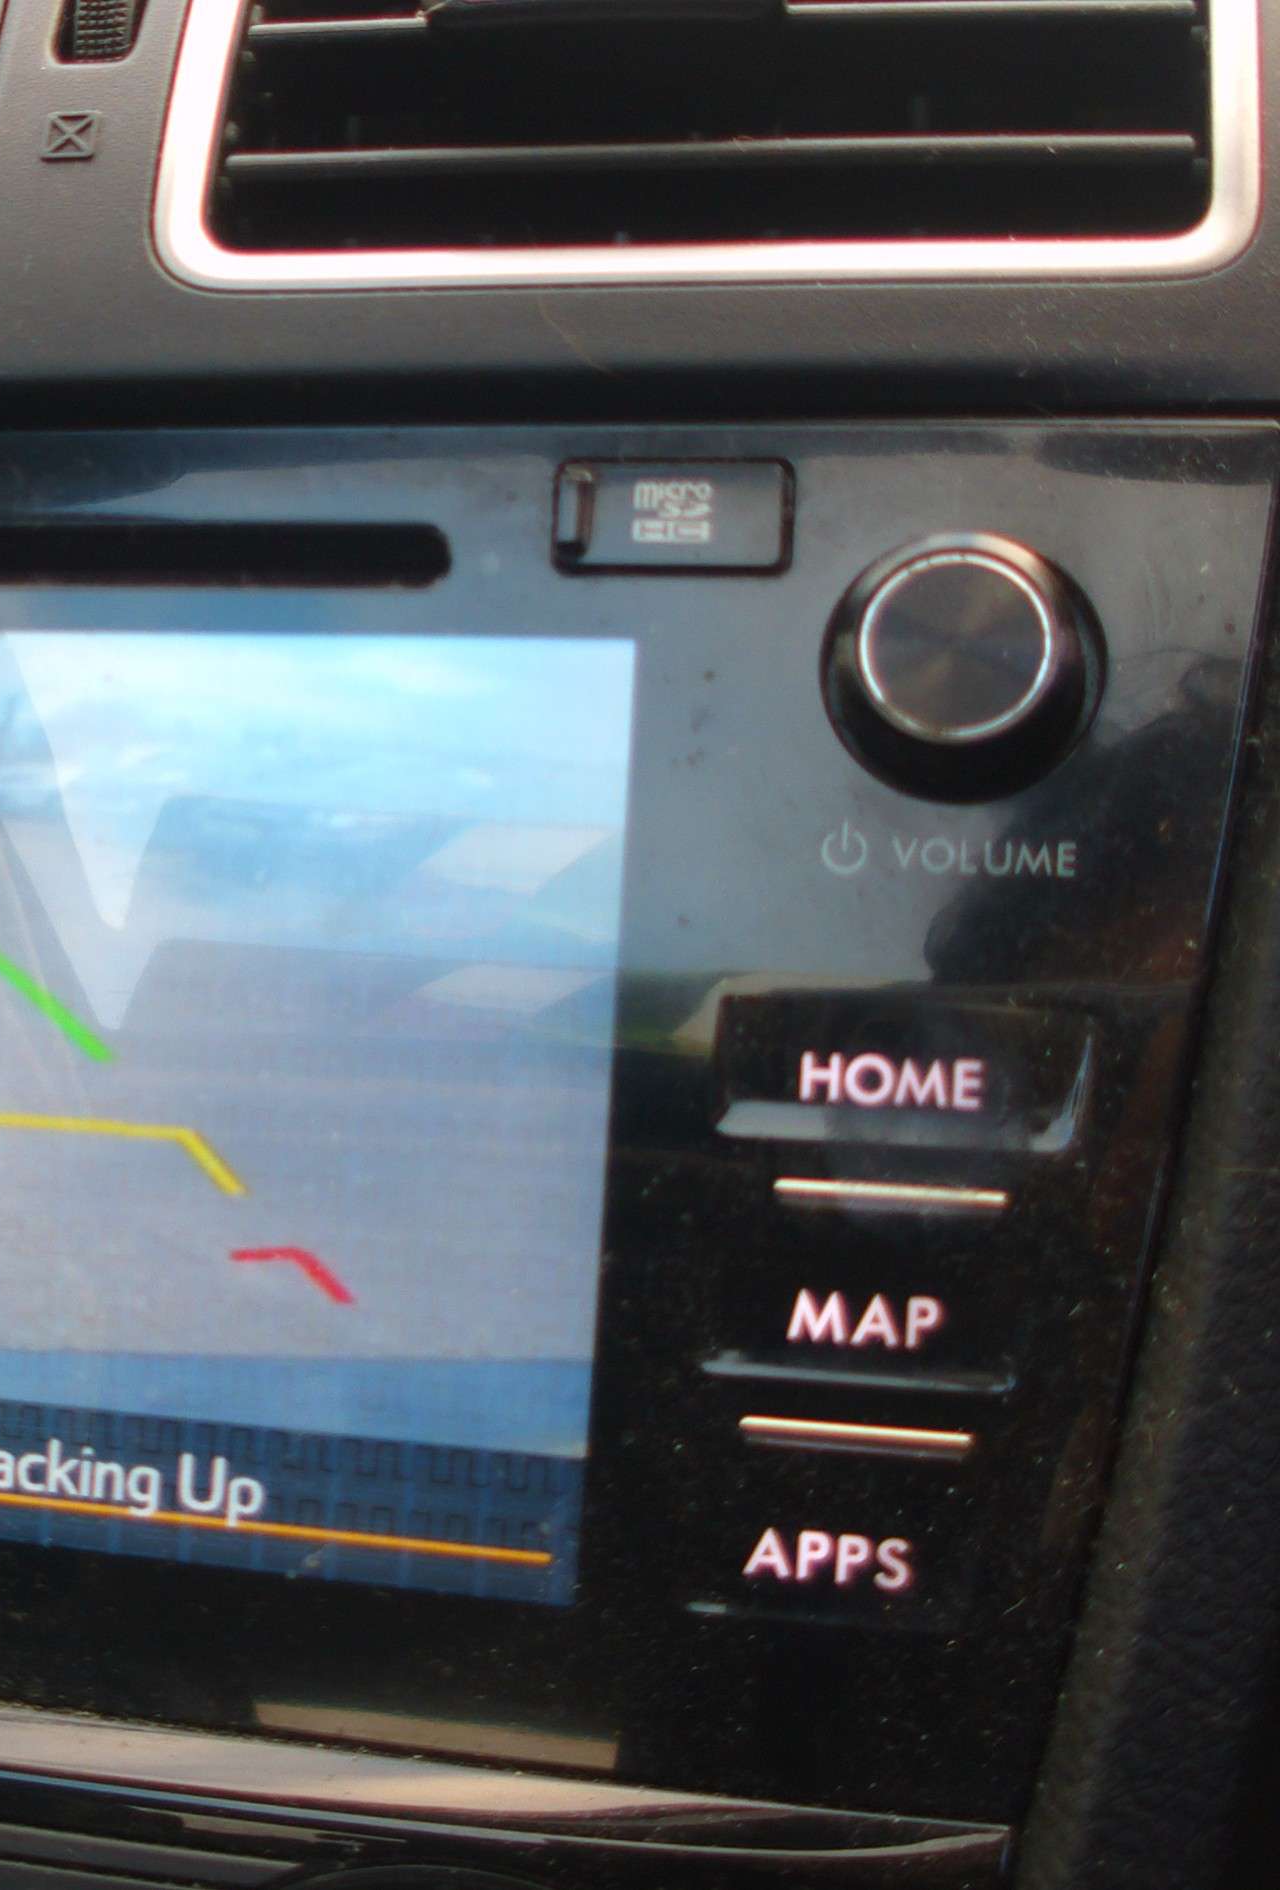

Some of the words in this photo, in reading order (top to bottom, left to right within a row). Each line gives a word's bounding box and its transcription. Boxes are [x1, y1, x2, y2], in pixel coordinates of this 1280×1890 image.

[892, 836, 1079, 878] VOLUME
[799, 1051, 984, 1110] HOME
[786, 1288, 944, 1349] MAP
[177, 1452, 265, 1527] Up
[742, 1526, 914, 1592] APPS
